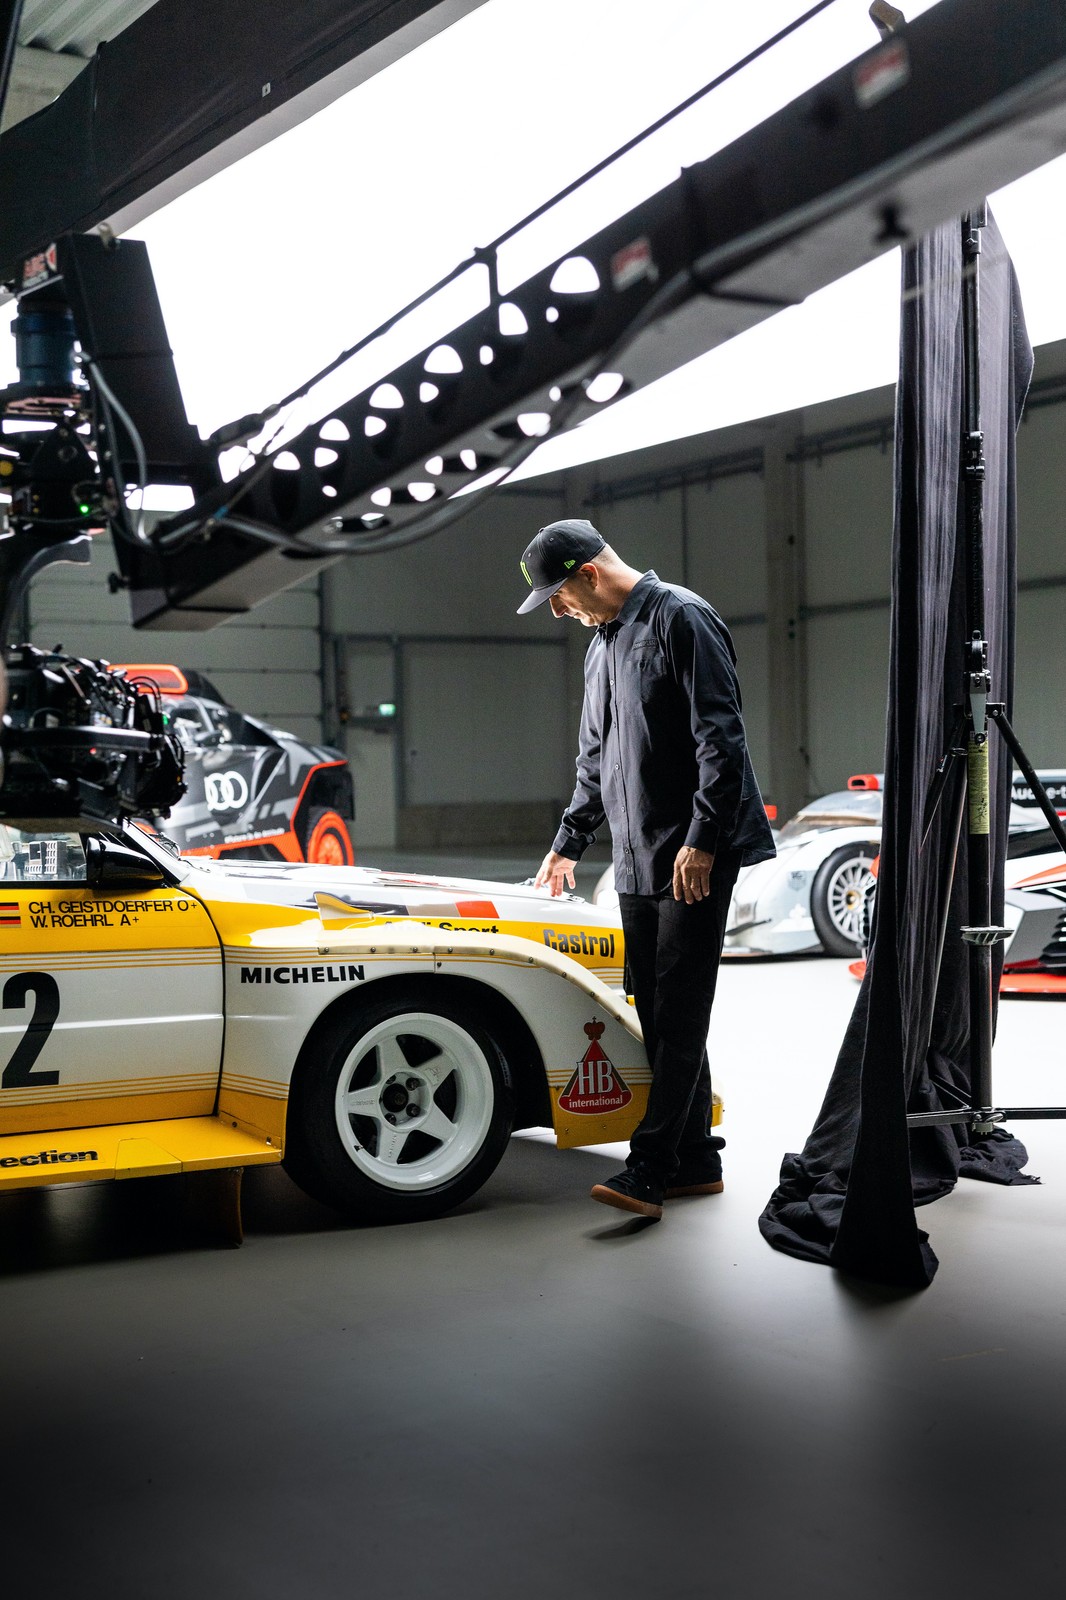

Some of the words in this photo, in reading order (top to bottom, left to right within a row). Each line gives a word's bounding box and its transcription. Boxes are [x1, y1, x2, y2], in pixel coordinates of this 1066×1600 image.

[28, 901, 55, 914] CH.
[59, 900, 173, 913] GEISTDOERFER
[30, 915, 48, 928] W.
[52, 914, 114, 928] ROEHRL
[543, 929, 615, 959] Castrol
[240, 965, 366, 984] MICHELIN
[2, 971, 60, 1089] 2
[577, 1060, 614, 1095] HB
[569, 1095, 623, 1108] international
[0, 1150, 98, 1167] ection
